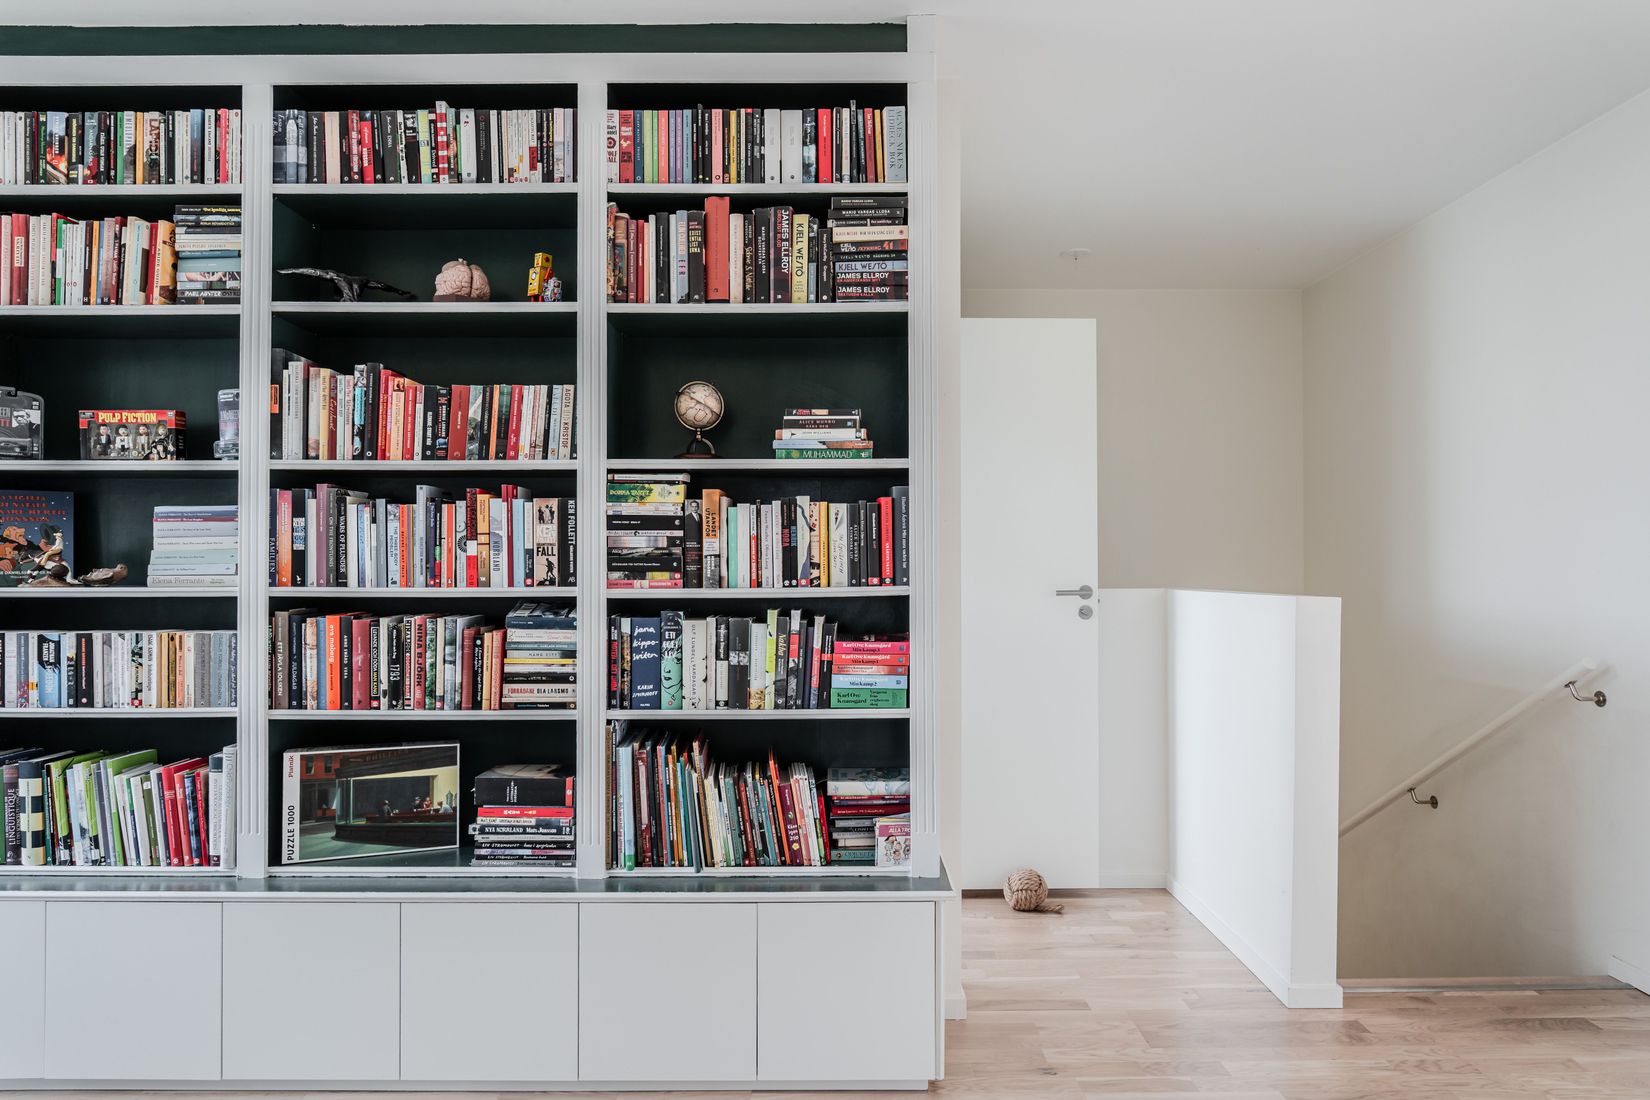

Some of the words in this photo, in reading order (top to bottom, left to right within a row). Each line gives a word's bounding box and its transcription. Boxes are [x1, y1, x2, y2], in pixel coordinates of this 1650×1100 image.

[795, 223, 805, 245] KJELL
[883, 241, 894, 250] 41
[795, 247, 805, 277] WESTÖ
[838, 262, 859, 271] KJELL
[860, 262, 888, 270] WESTÖ
[98, 412, 121, 423] PULP
[121, 412, 157, 423] FICTION
[562, 421, 570, 449] KRISTOF
[802, 450, 853, 458] MUHAMMAD
[568, 500, 576, 514] KEN
[329, 516, 334, 525] ON
[568, 515, 576, 544] FOLLETT
[339, 534, 346, 542] OF
[492, 541, 500, 572] NORRLAND
[536, 546, 557, 557] FALL
[416, 624, 424, 649] NINA
[634, 626, 656, 637] jana
[778, 633, 787, 656] Nakba
[389, 664, 400, 681] 1793
[416, 652, 424, 687] BJÖRK
[8, 788, 16, 845] LINGUISTIQUE
[287, 828, 295, 861] PUZZLE
